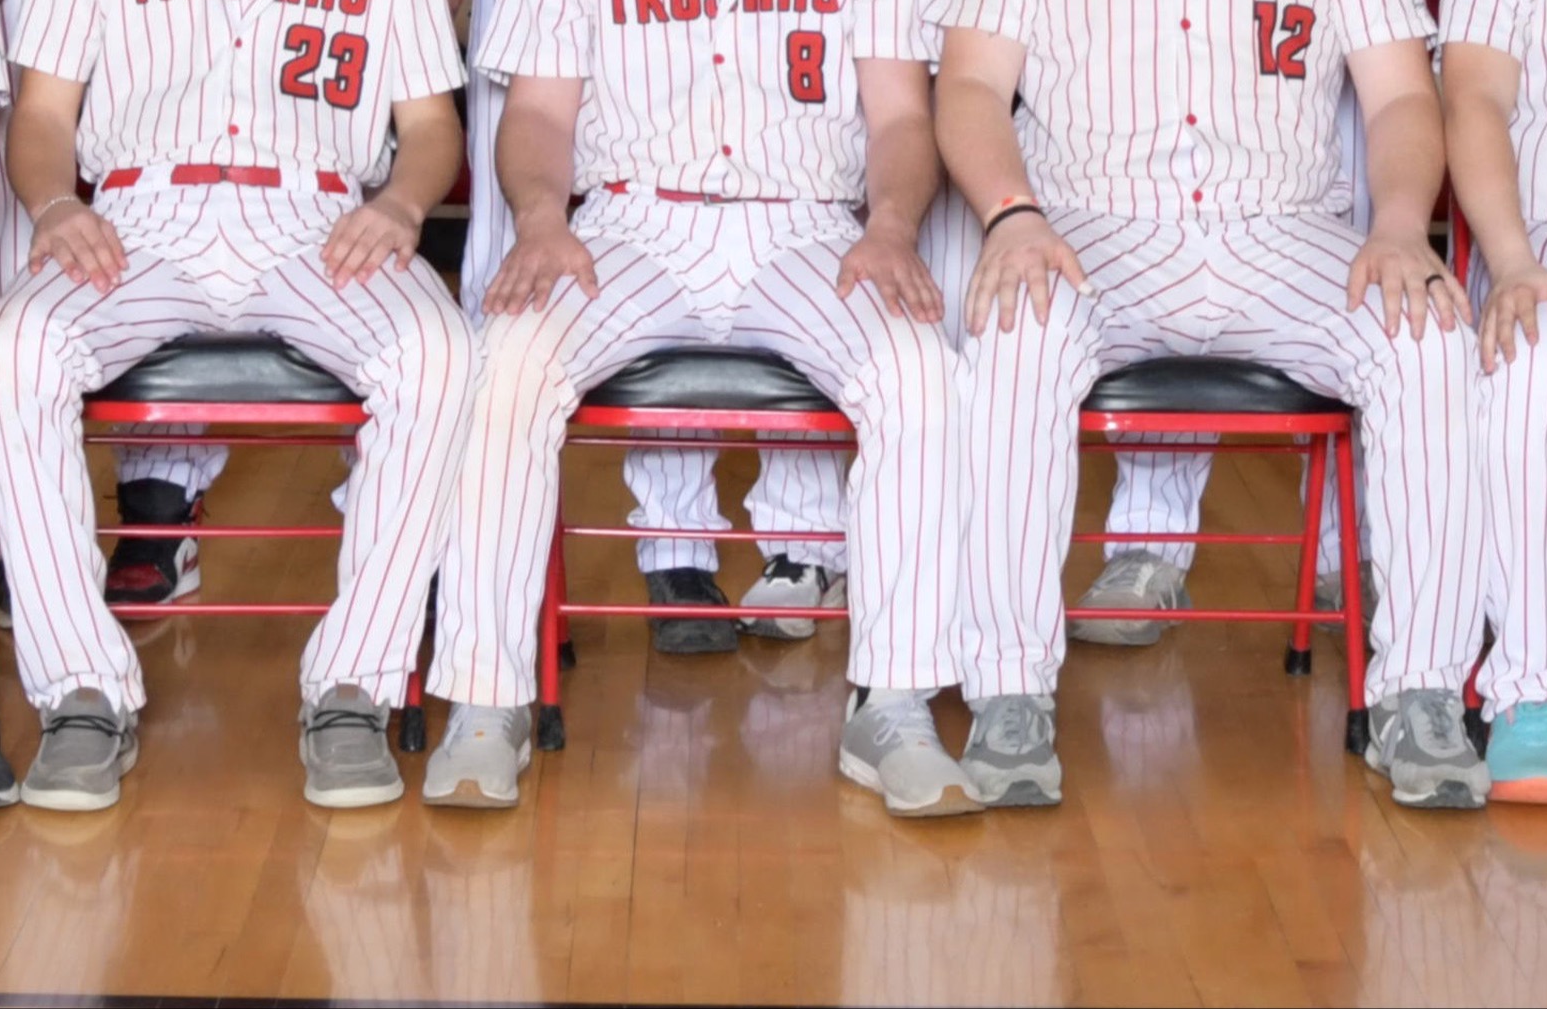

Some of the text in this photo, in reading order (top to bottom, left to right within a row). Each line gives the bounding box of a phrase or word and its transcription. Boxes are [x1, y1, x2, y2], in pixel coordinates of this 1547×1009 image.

[280, 23, 370, 111] 23
[786, 30, 827, 104] 8
[1254, 0, 1316, 80] 12
